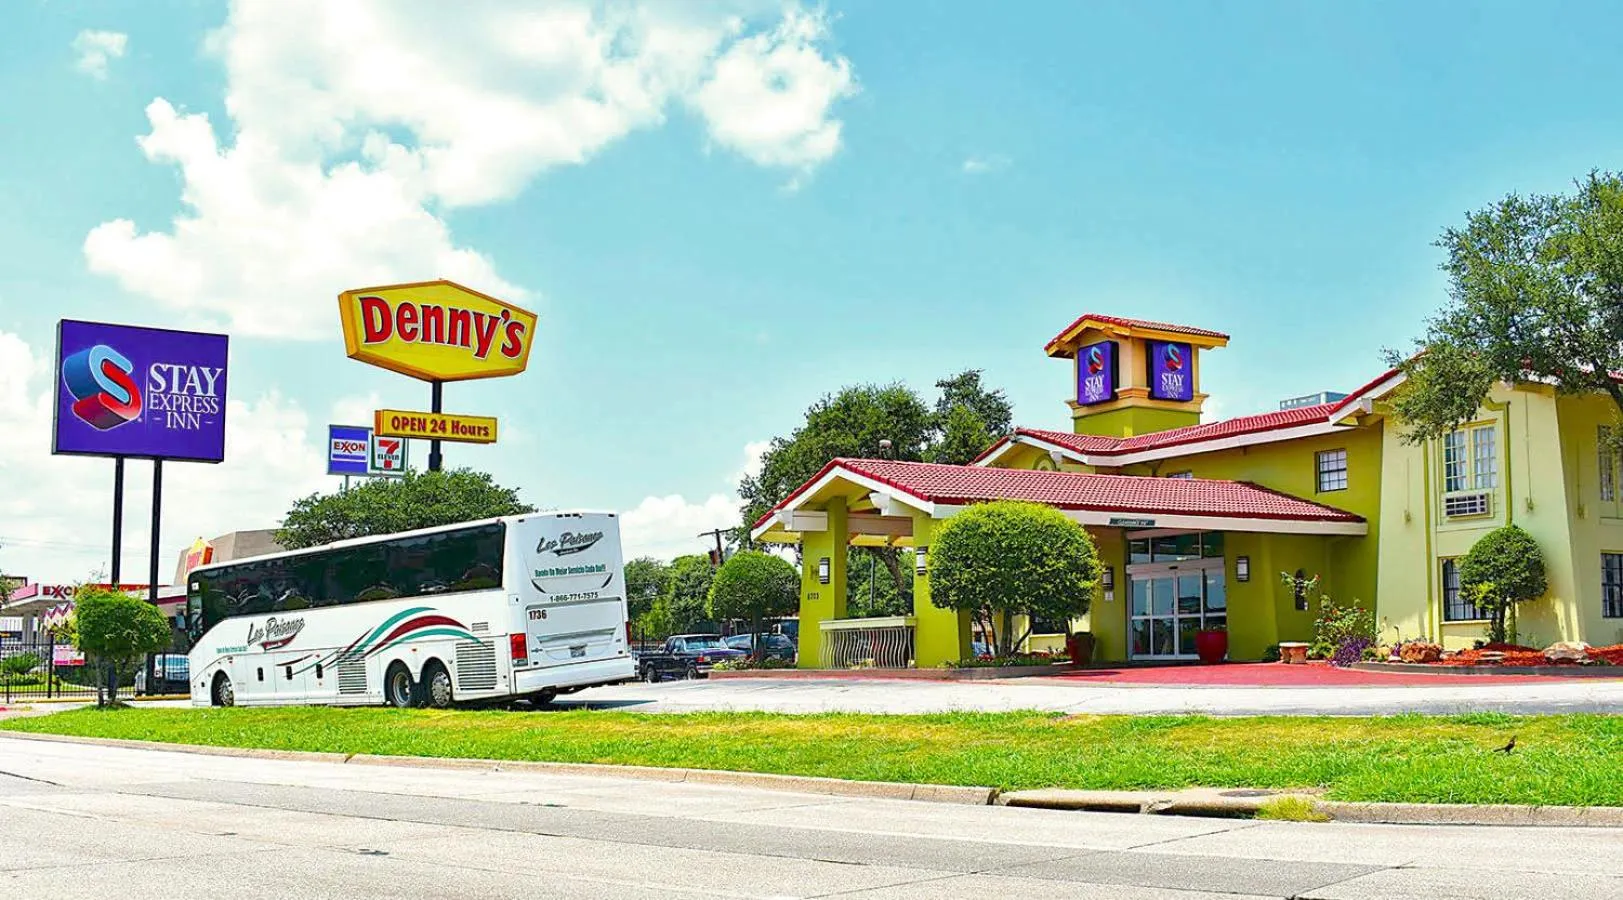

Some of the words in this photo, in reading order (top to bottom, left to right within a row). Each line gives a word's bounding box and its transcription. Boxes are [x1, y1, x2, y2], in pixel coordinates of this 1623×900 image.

[359, 296, 525, 359] Denny's
[149, 362, 223, 397] STAY
[1085, 375, 1104, 389] STAY
[1161, 373, 1184, 386] STAY
[149, 393, 219, 415] EXPRESS
[166, 413, 201, 430] INN
[391, 416, 427, 433] OPEN
[430, 419, 447, 434] 24
[451, 420, 490, 437] Hours
[333, 441, 366, 454] EXXON
[529, 609, 547, 620] 1736
